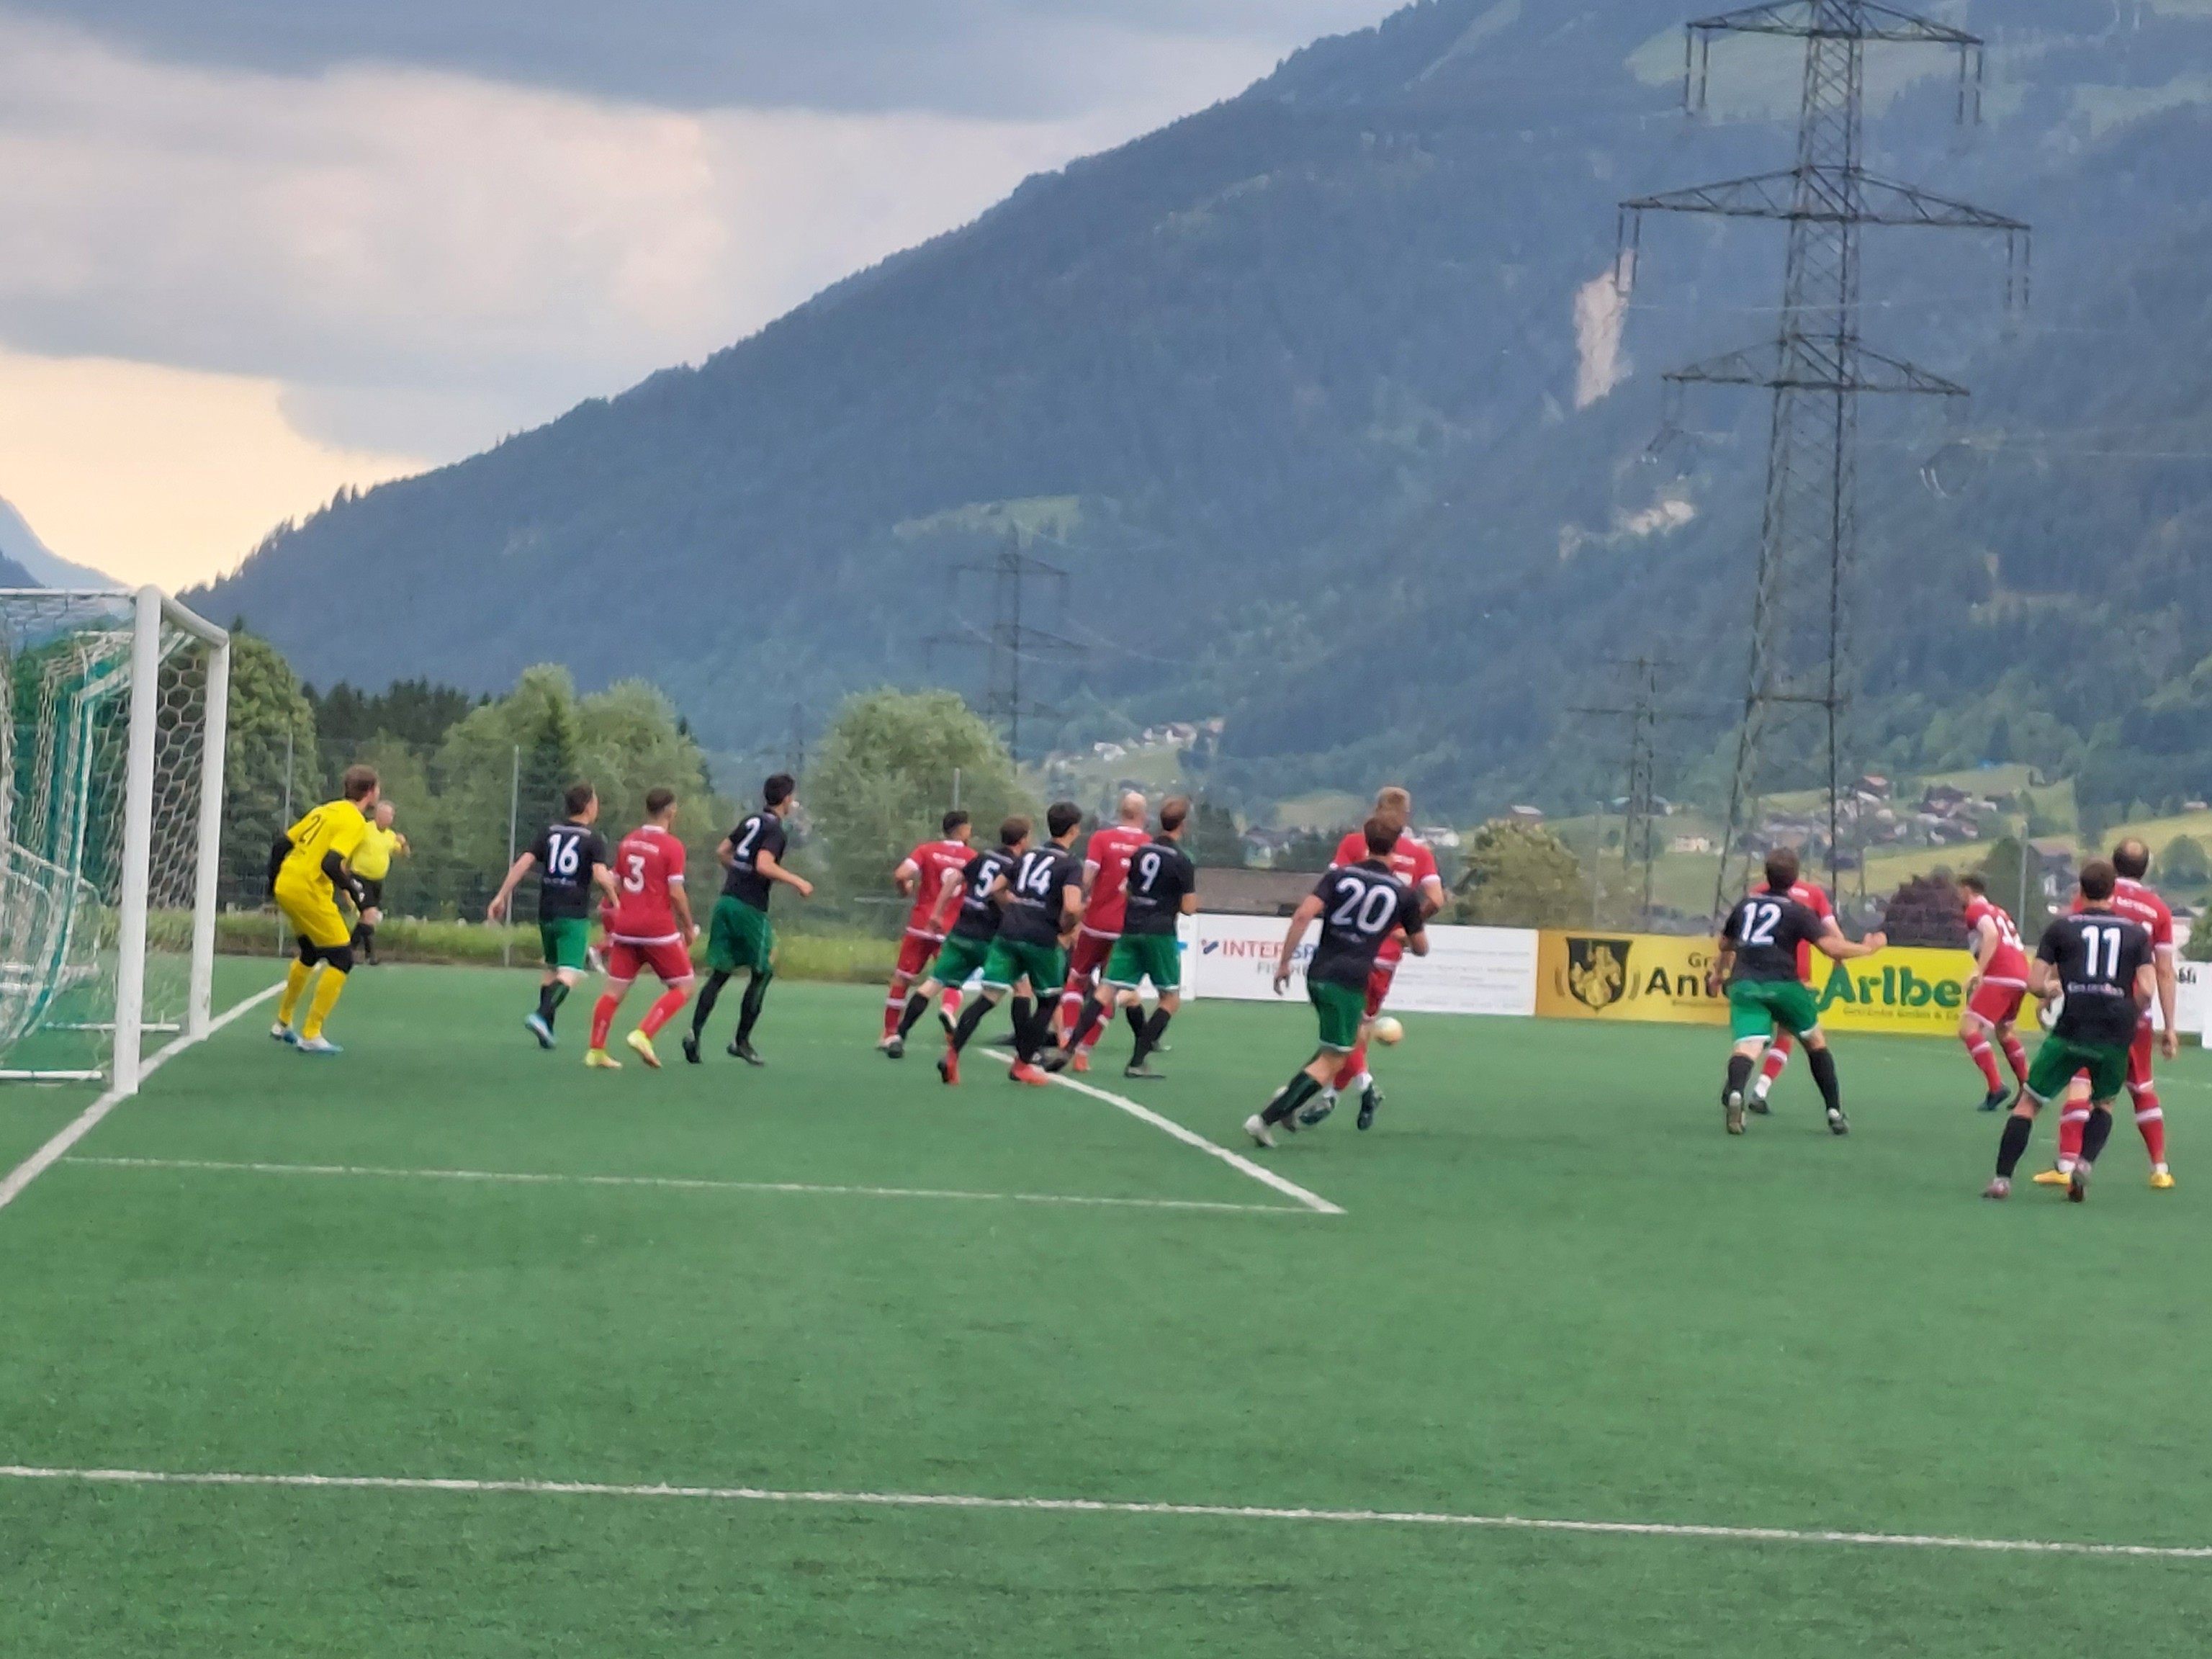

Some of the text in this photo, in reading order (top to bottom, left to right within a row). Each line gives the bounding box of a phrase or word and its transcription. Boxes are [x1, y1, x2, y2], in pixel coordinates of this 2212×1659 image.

[549, 833, 580, 876] 16
[736, 817, 761, 857] 2
[623, 854, 646, 892] 3
[974, 859, 1001, 897] 5
[1016, 852, 1056, 896] 14
[1140, 852, 1161, 892] 9
[1330, 876, 1398, 934] 20
[1742, 902, 1782, 944] 12
[2081, 925, 2122, 979] 11
